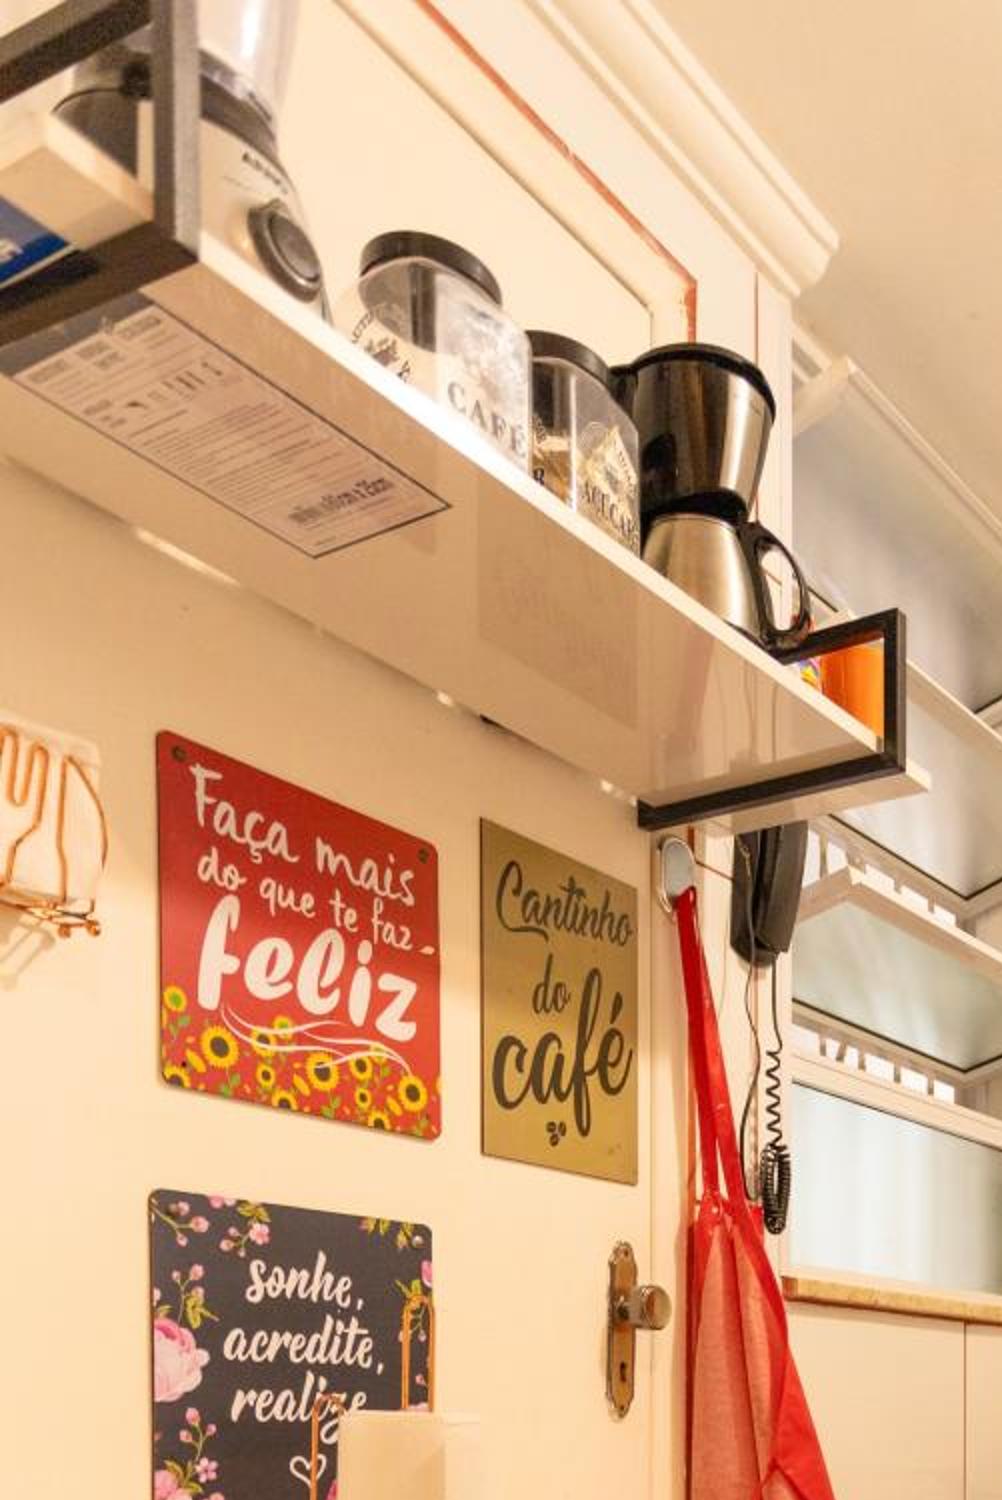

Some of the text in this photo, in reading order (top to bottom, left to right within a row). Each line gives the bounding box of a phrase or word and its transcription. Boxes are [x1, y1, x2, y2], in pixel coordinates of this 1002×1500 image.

[189, 763, 415, 906] Faça mais
[197, 846, 413, 950] do que te faz
[496, 860, 633, 947] Cantinho
[197, 894, 418, 1042] feliz
[532, 952, 572, 1015] do
[491, 967, 634, 1138] café
[245, 1250, 364, 1311] sonhe,
[223, 1314, 385, 1376] acredite,
